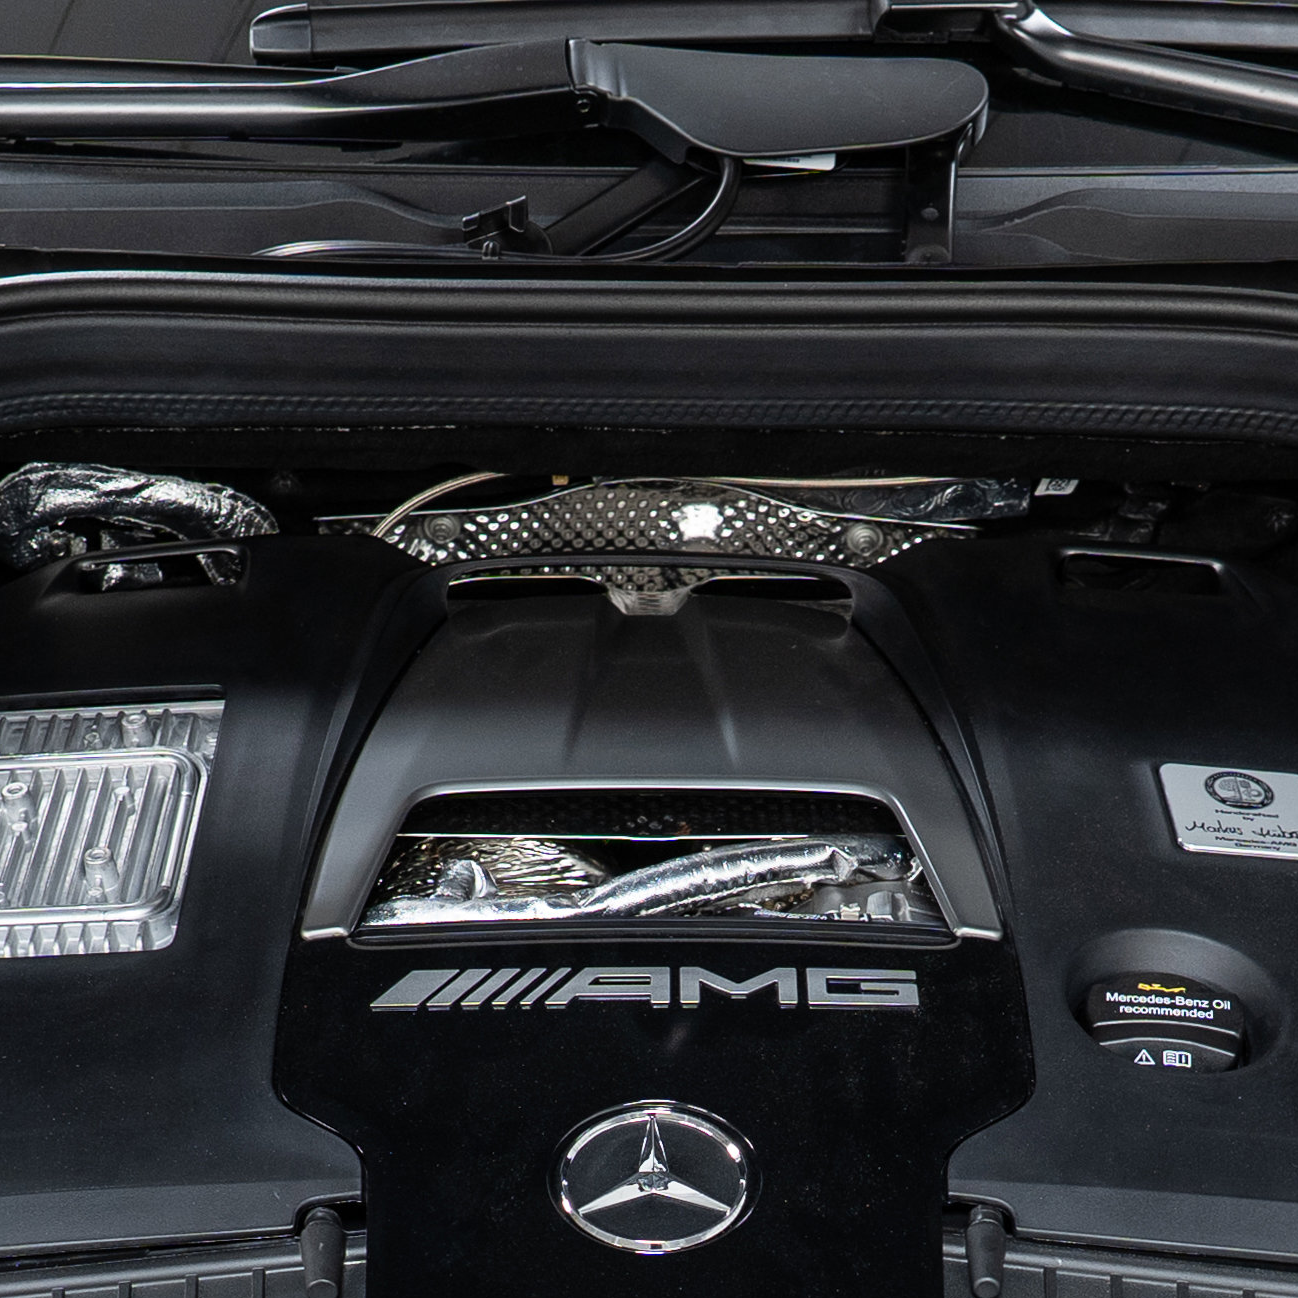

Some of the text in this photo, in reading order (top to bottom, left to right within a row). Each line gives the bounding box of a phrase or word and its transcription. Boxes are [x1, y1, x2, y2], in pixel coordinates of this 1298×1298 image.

[545, 967, 919, 1009] AMG
[1105, 991, 1231, 1010] Mercedes-Benz Oil
[1119, 1005, 1214, 1019] recommended
